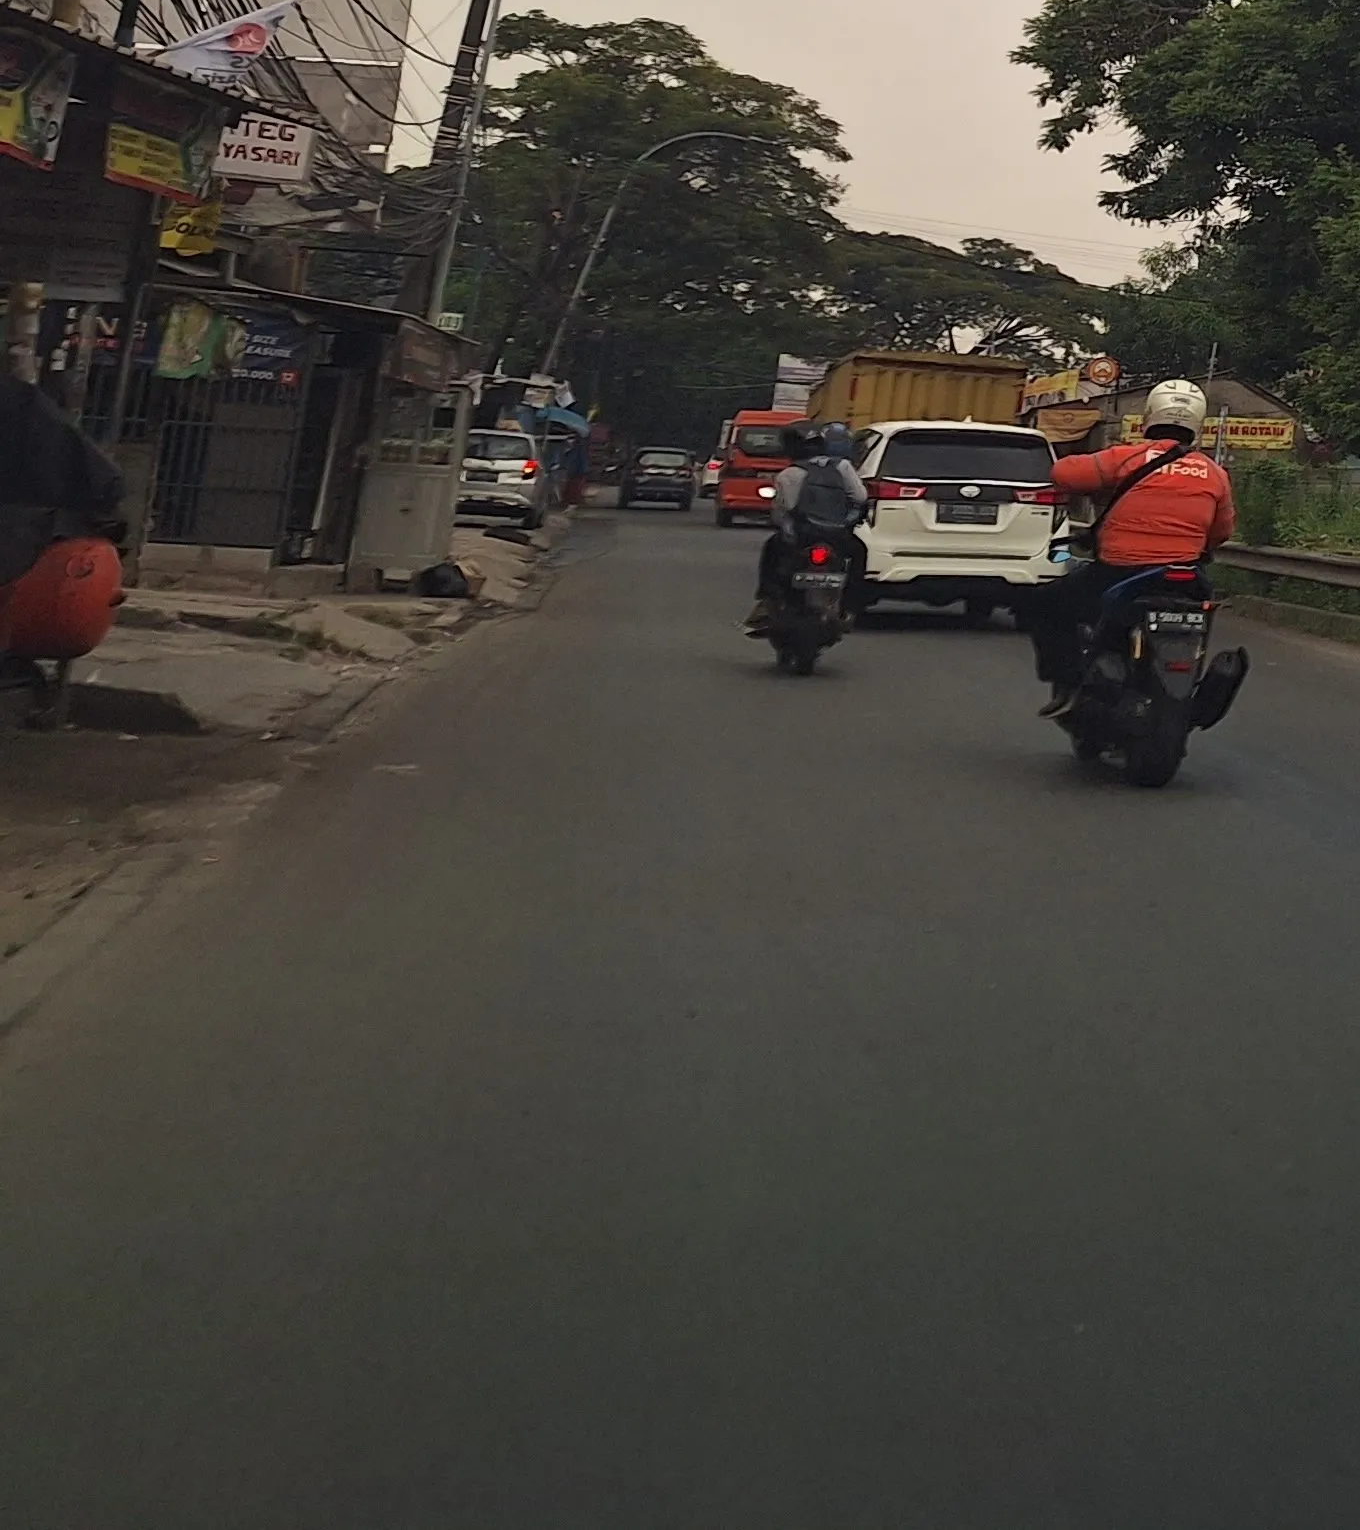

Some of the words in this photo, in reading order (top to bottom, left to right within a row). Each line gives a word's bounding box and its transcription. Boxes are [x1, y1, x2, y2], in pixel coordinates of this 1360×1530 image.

[229, 118, 298, 142] TEG
[218, 142, 301, 166] YASARI
[1169, 463, 1208, 479] Food
